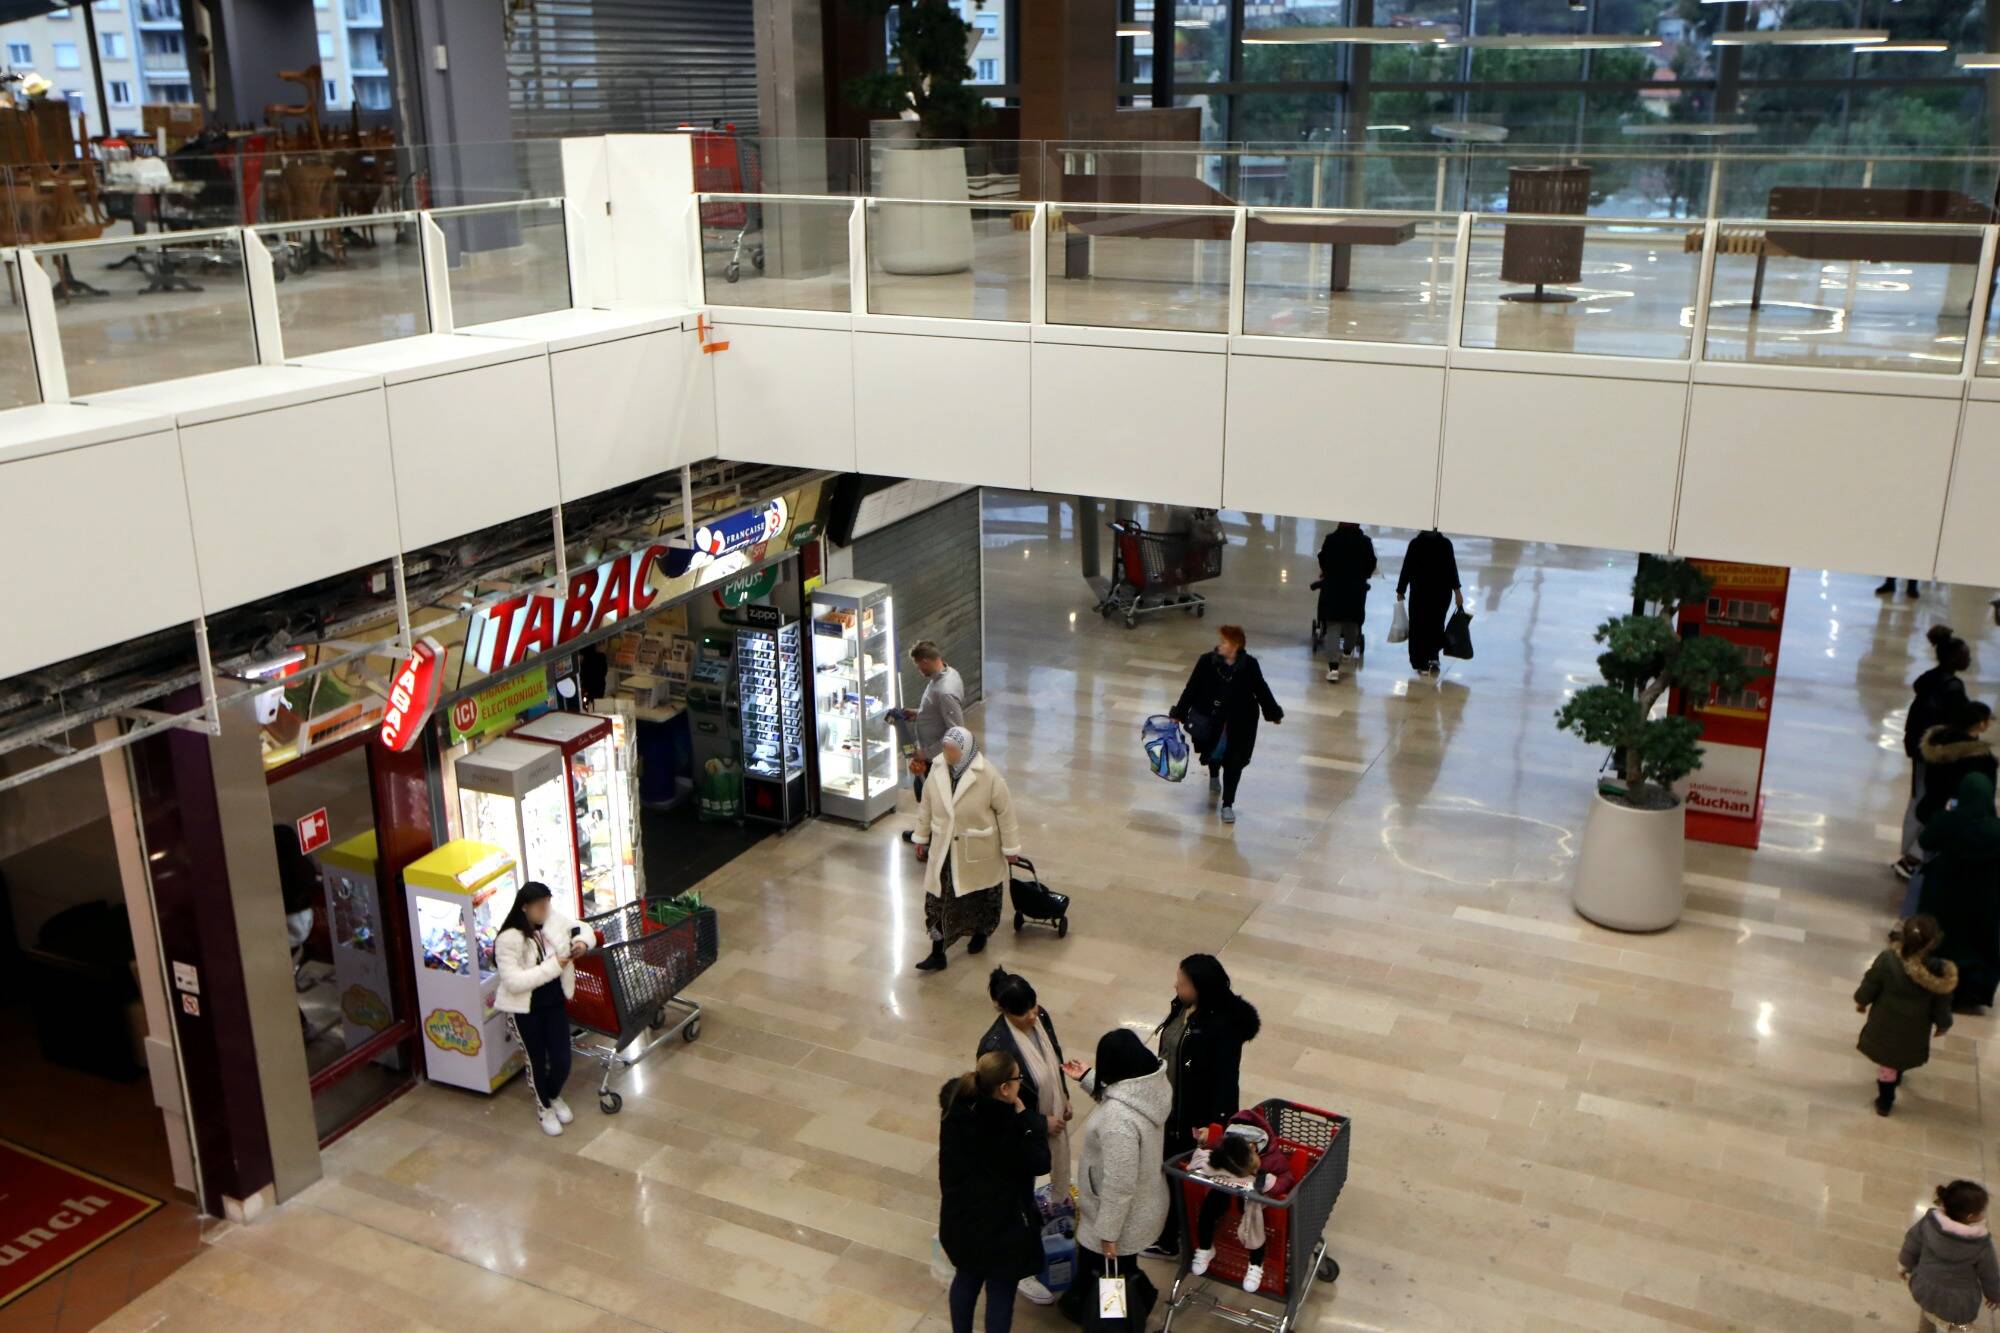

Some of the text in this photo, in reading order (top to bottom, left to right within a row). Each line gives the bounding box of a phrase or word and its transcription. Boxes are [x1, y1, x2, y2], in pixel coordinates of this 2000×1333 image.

[726, 522, 765, 544] FRANÇAISE
[1731, 575, 1776, 585] AUCHAN
[489, 544, 669, 673] TABAC
[381, 649, 425, 747] TABAC
[479, 674, 527, 702] CIGARETTE
[456, 703, 476, 726] ICI
[1688, 782, 1748, 796] station service
[1685, 790, 1750, 813] Auchan
